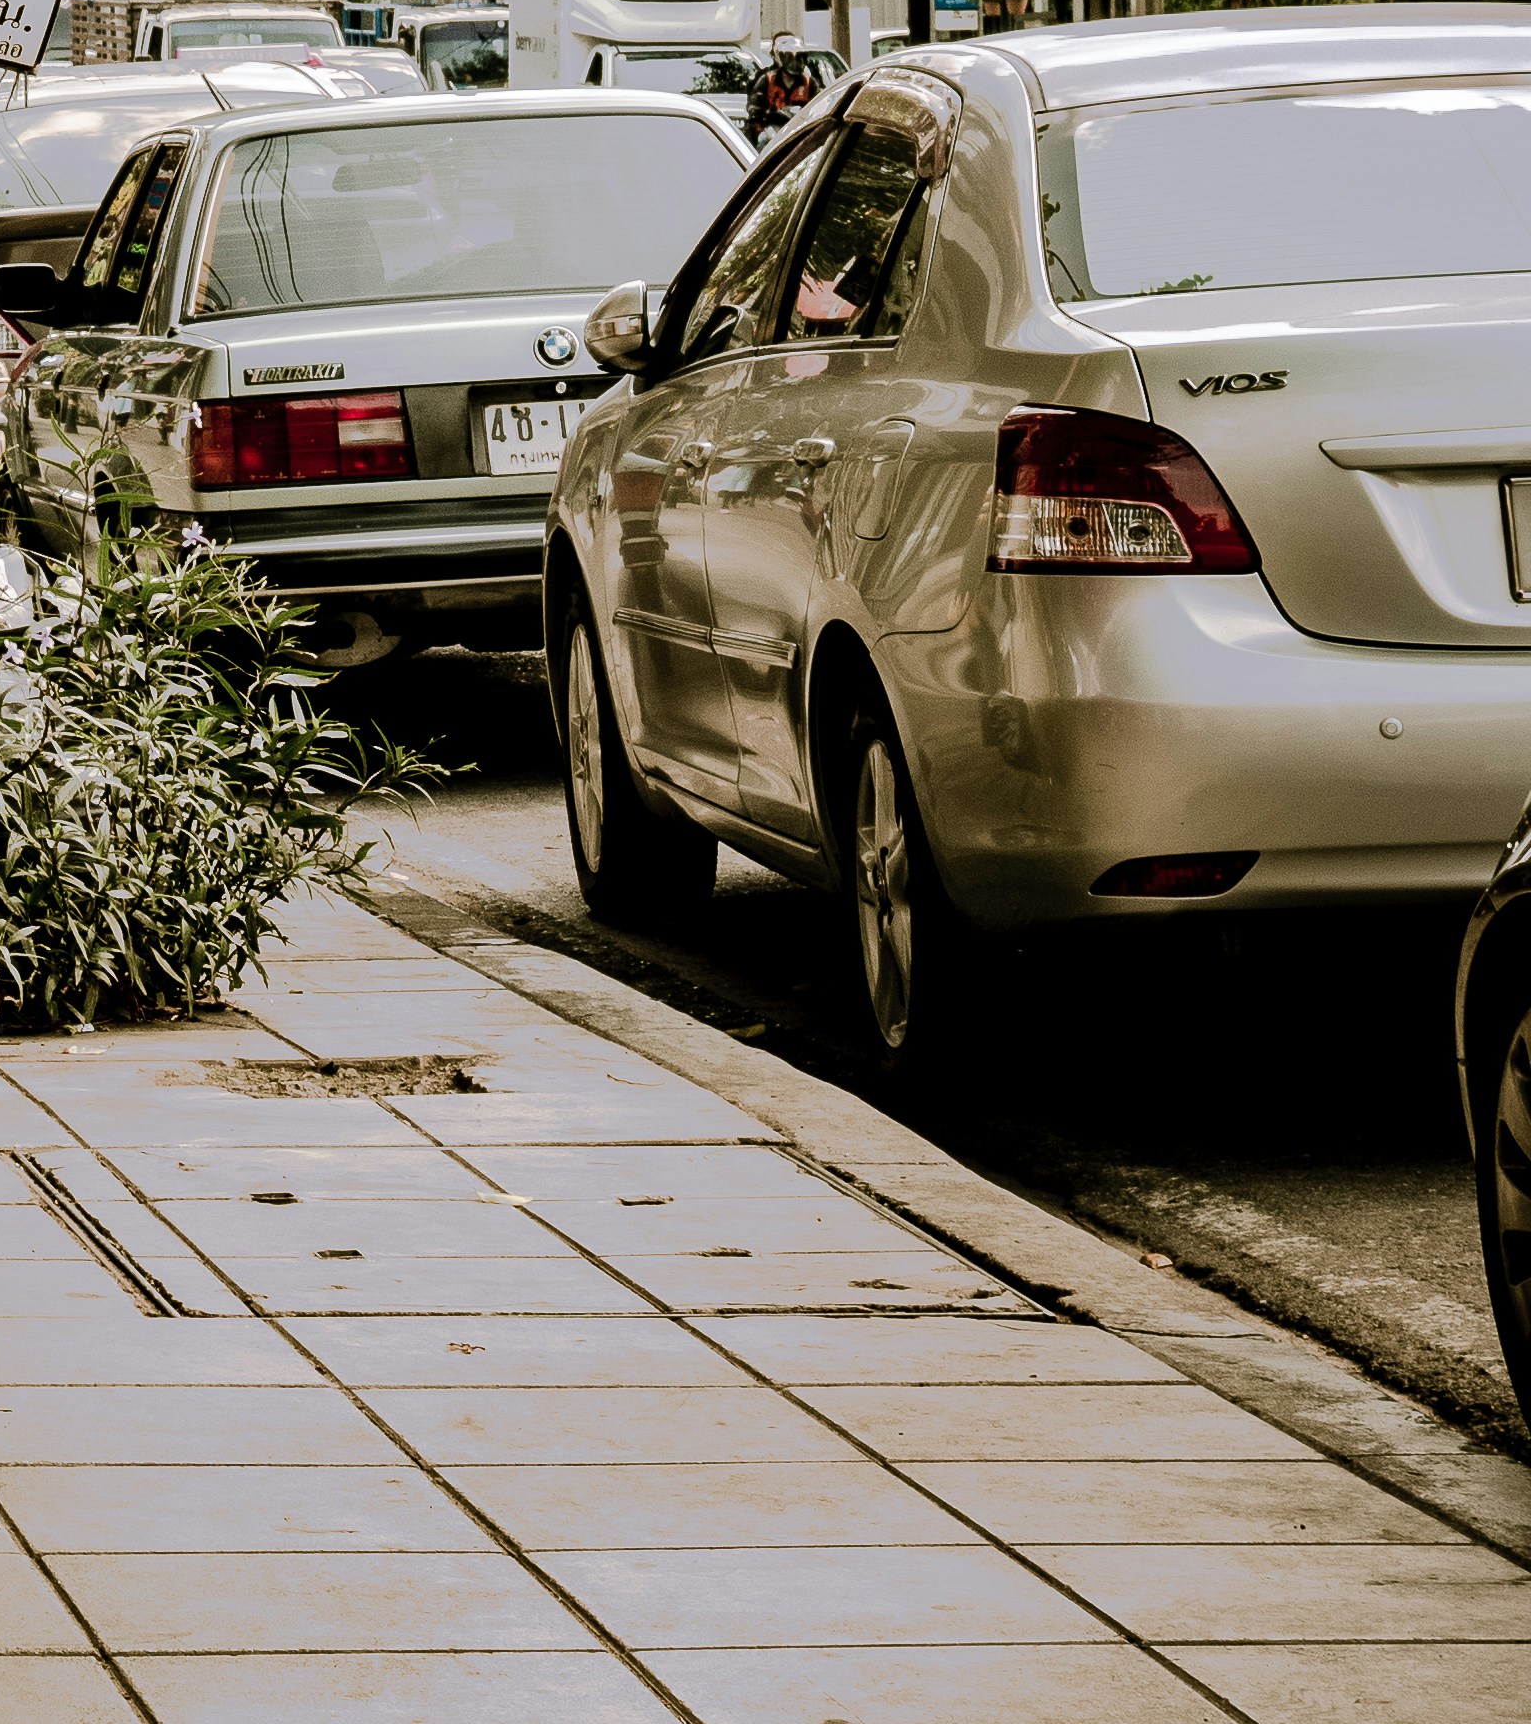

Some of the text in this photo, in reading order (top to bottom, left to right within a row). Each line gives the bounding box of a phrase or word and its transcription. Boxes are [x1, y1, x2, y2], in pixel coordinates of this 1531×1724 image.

[1178, 369, 1291, 397] VIOS
[510, 450, 561, 468] กรุงเทพ
